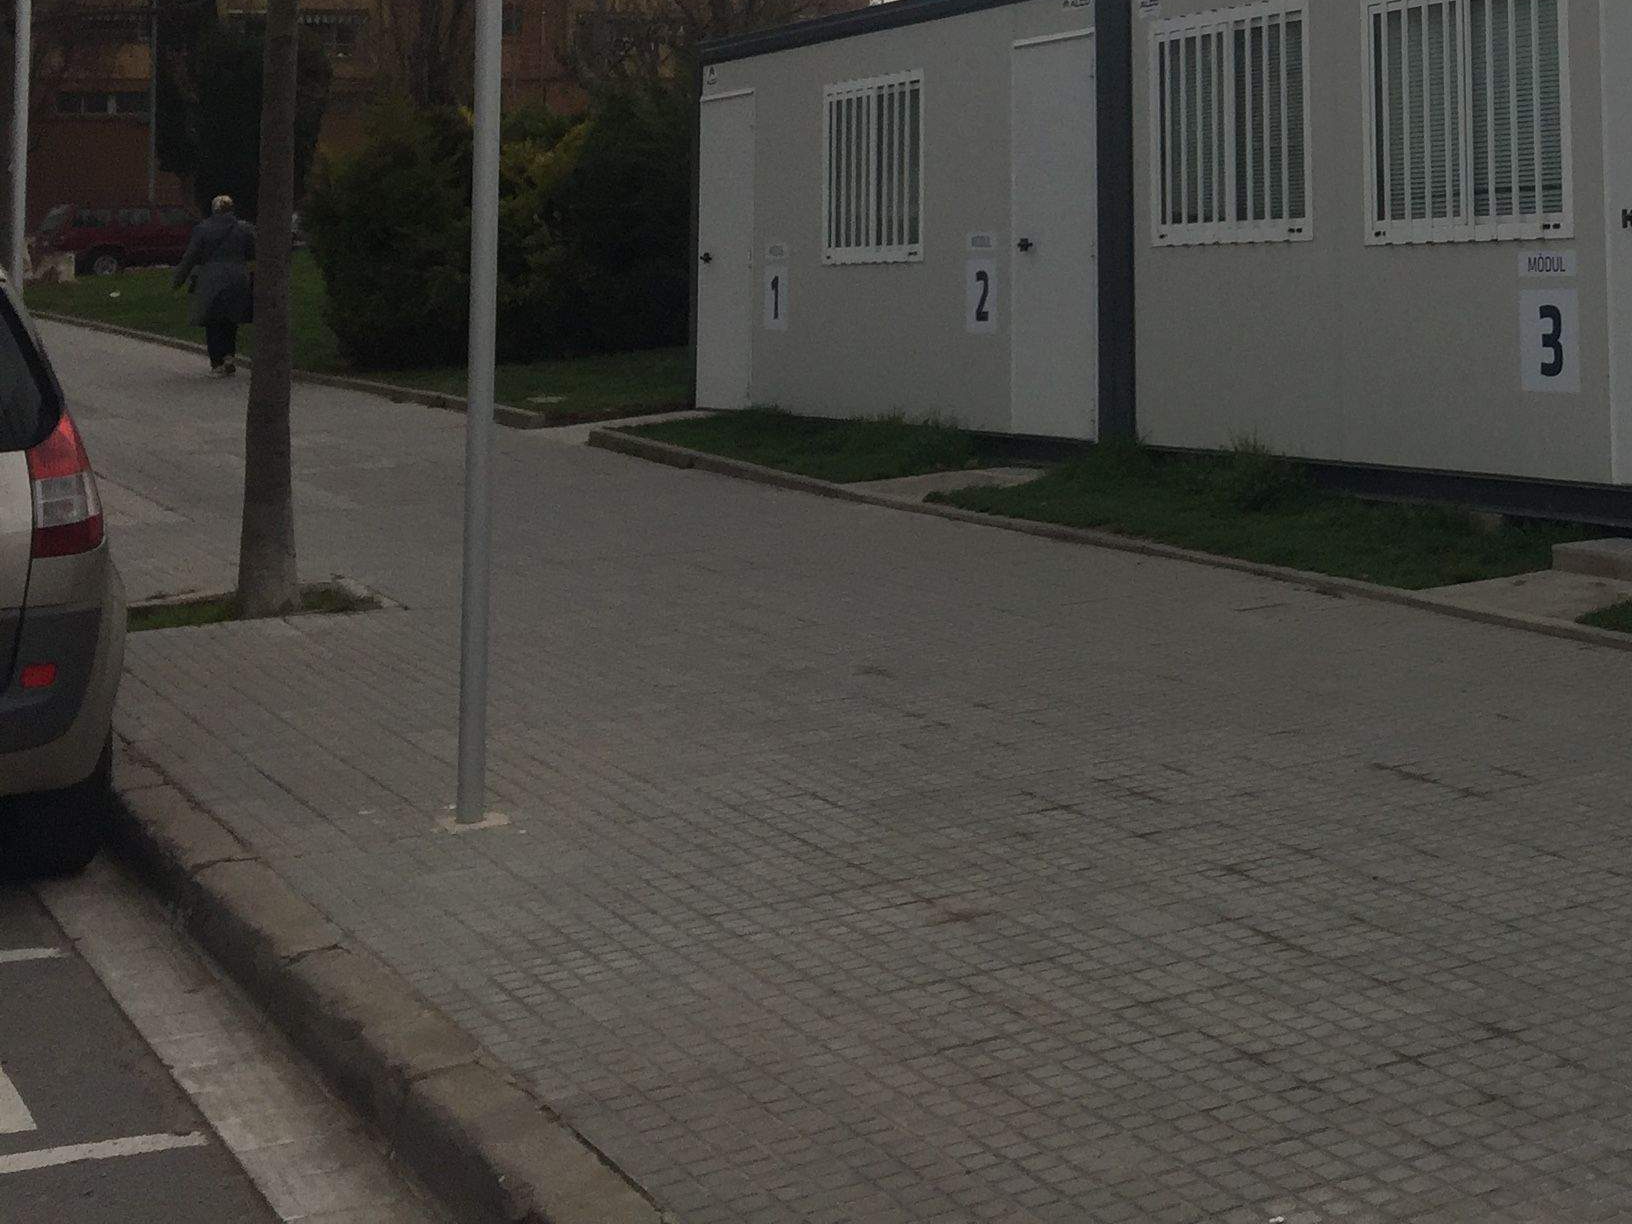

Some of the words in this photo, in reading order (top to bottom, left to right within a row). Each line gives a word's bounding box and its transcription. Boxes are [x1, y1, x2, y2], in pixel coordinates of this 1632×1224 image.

[771, 276, 779, 320] 1
[975, 270, 989, 322] 2
[1539, 304, 1564, 377] 3
